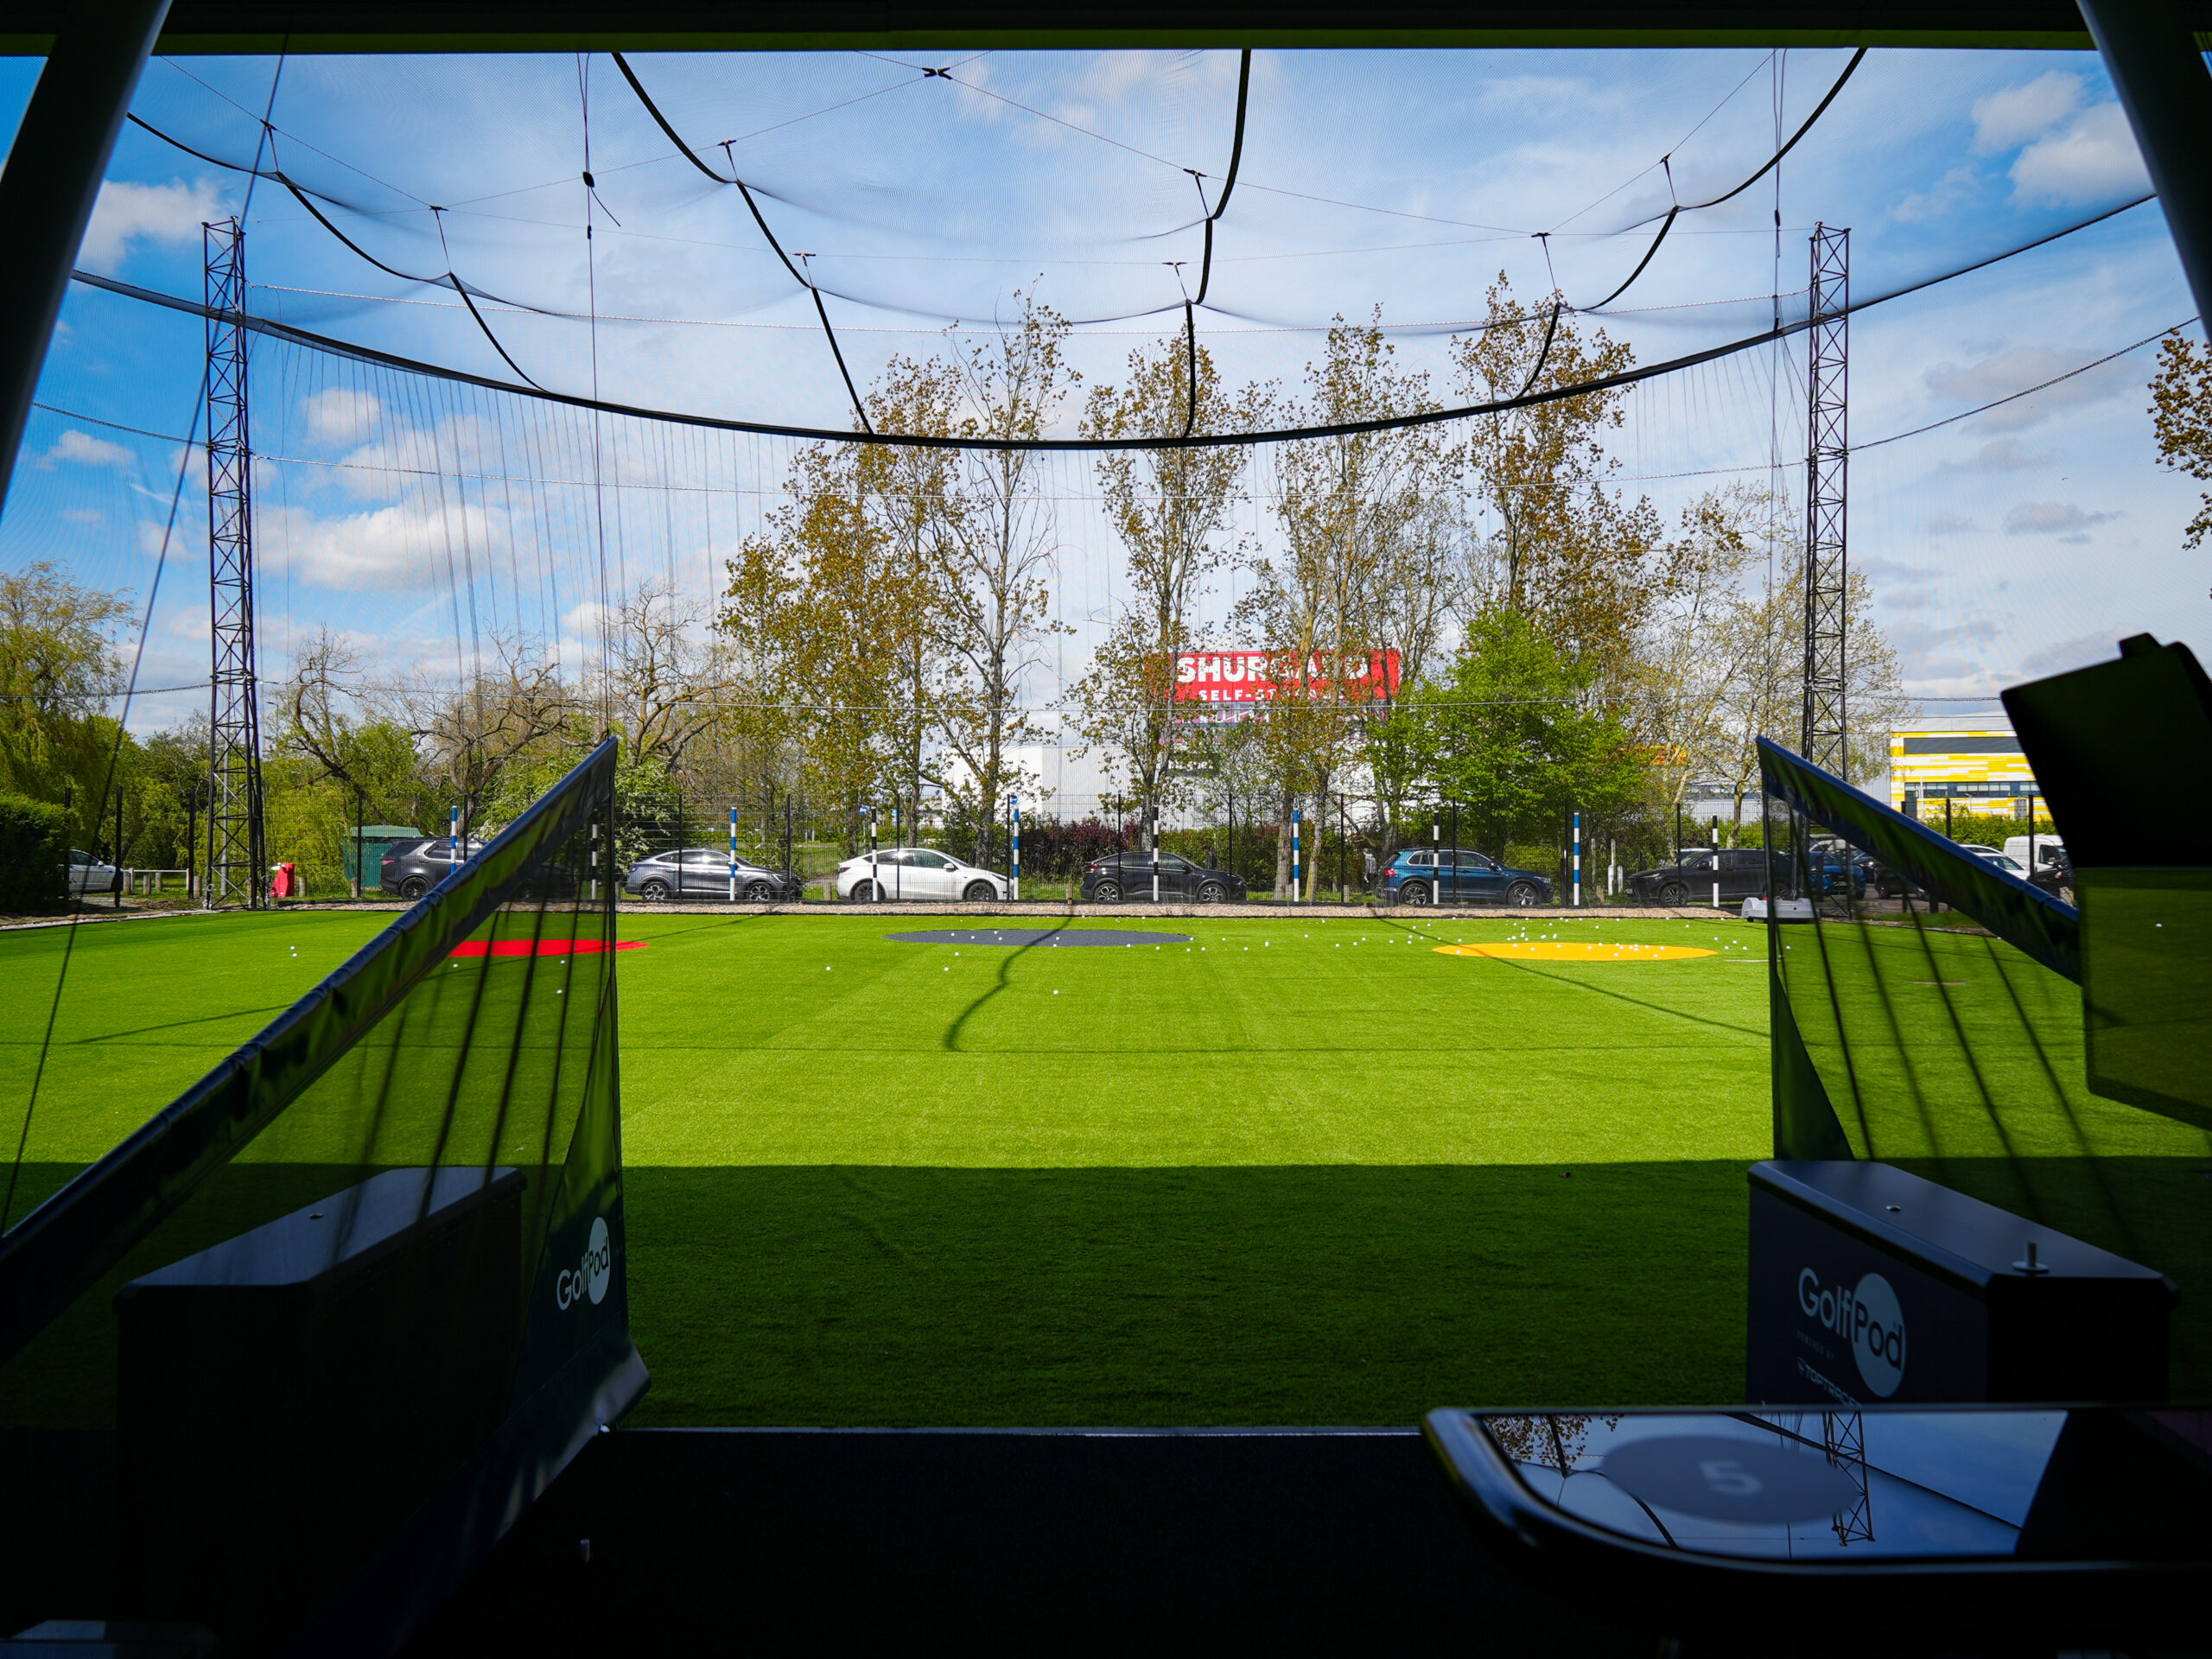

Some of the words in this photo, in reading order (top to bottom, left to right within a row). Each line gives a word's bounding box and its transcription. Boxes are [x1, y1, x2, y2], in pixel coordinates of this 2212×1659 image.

[556, 1236, 610, 1311] GolfPod
[1798, 1267, 1904, 1372] GolfPod
[1699, 1459, 1763, 1497] 5
